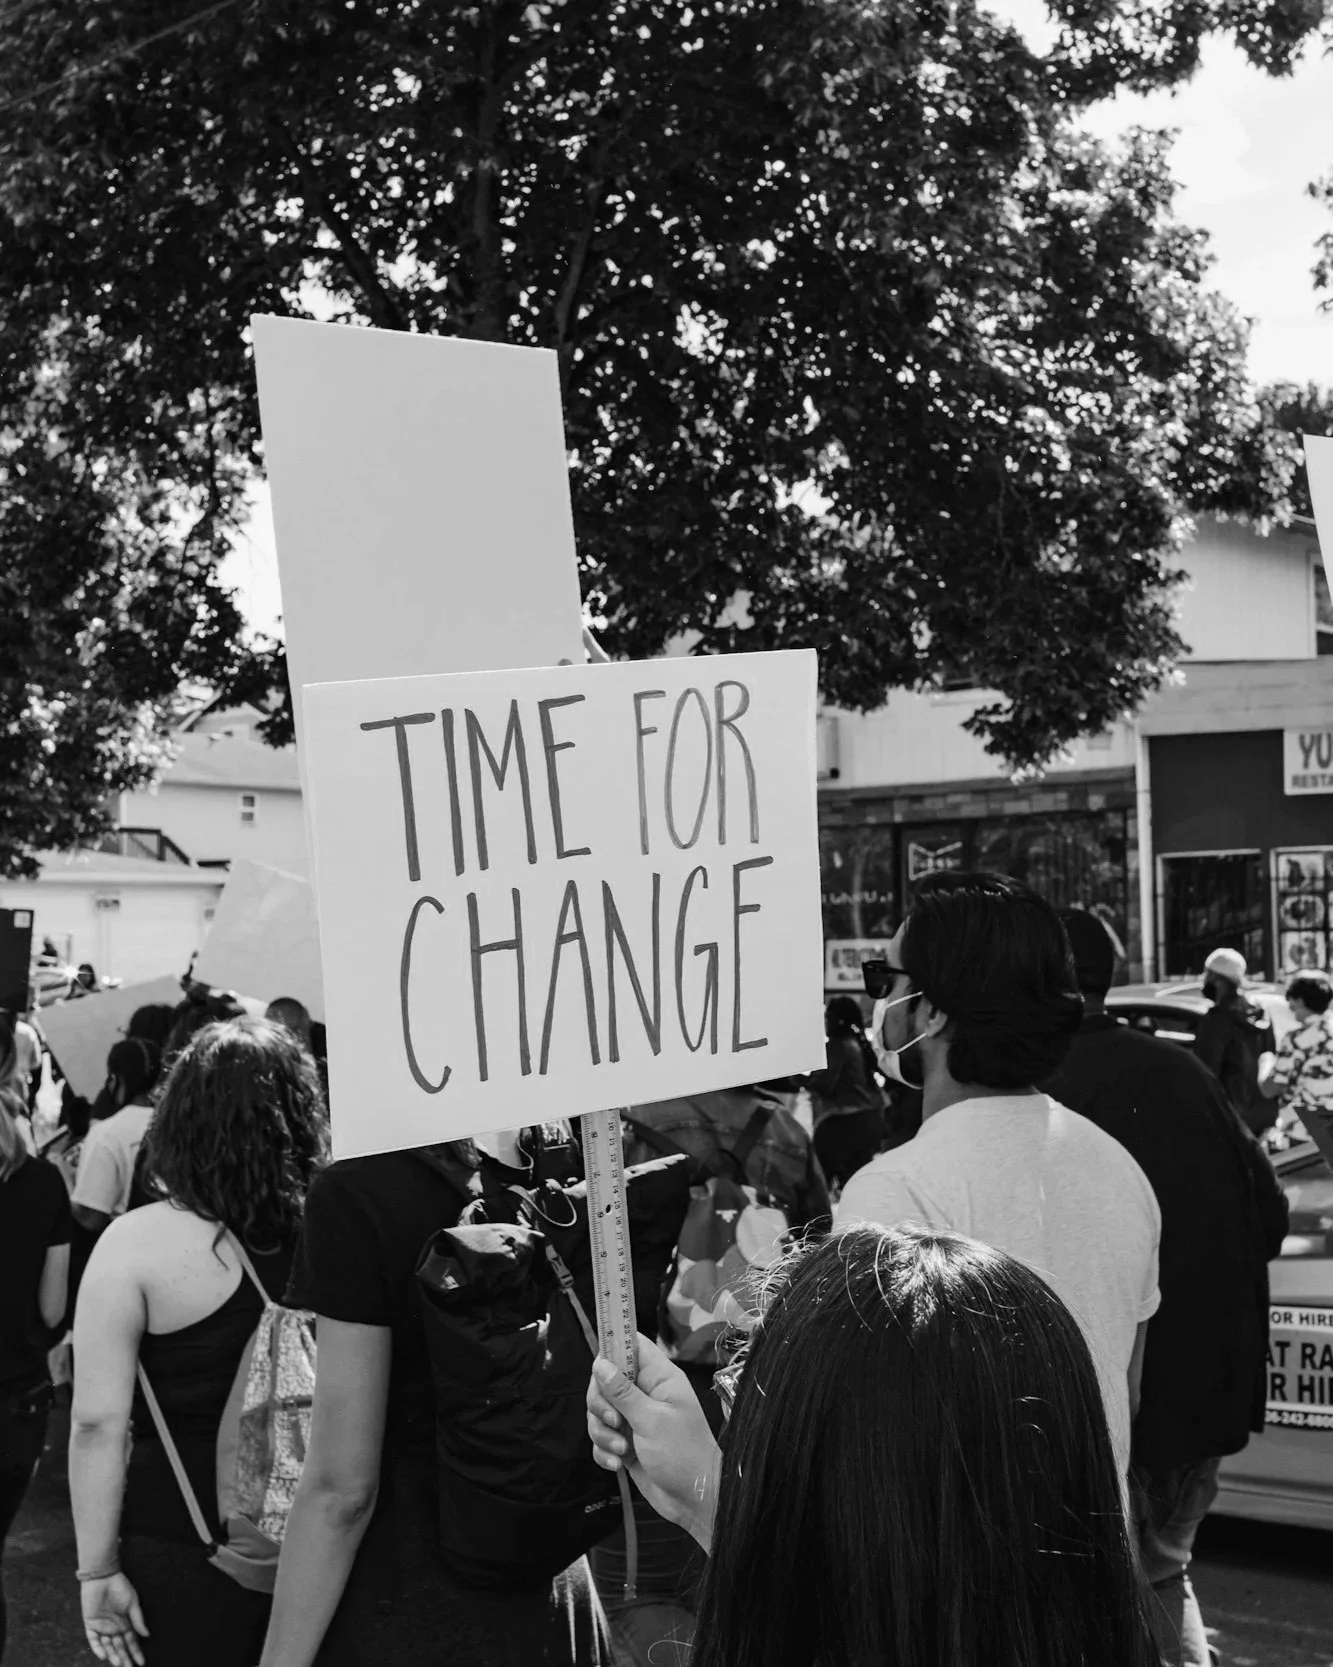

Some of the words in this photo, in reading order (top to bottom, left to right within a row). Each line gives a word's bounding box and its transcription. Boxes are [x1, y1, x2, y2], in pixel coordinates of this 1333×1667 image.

[360, 694, 592, 882] TIME
[633, 680, 760, 856] FOR
[400, 855, 774, 1094] CHANGE
[1297, 1374, 1333, 1406] HI
